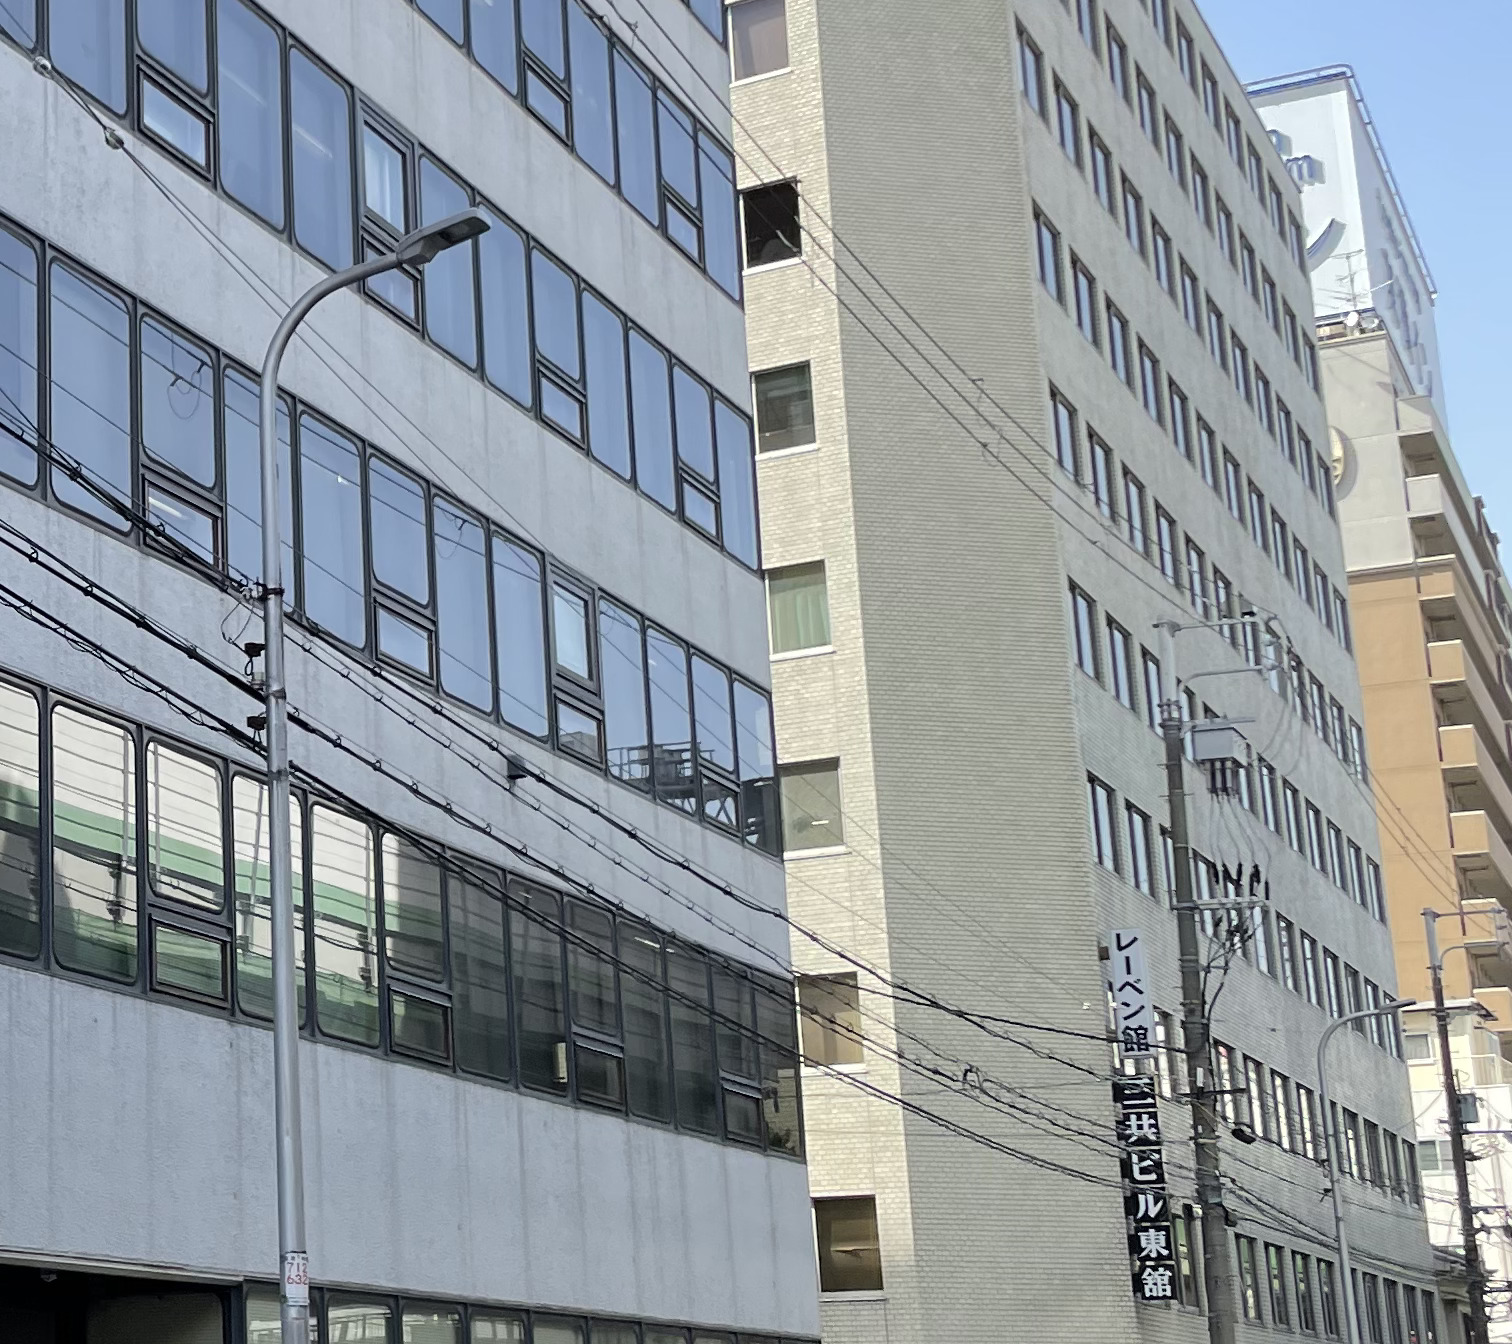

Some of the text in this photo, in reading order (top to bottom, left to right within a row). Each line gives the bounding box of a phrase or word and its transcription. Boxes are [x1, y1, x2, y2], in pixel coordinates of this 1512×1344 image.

[1115, 932, 1150, 1053] レーベン館
[287, 1261, 308, 1274] 712
[287, 1274, 308, 1285] 632
